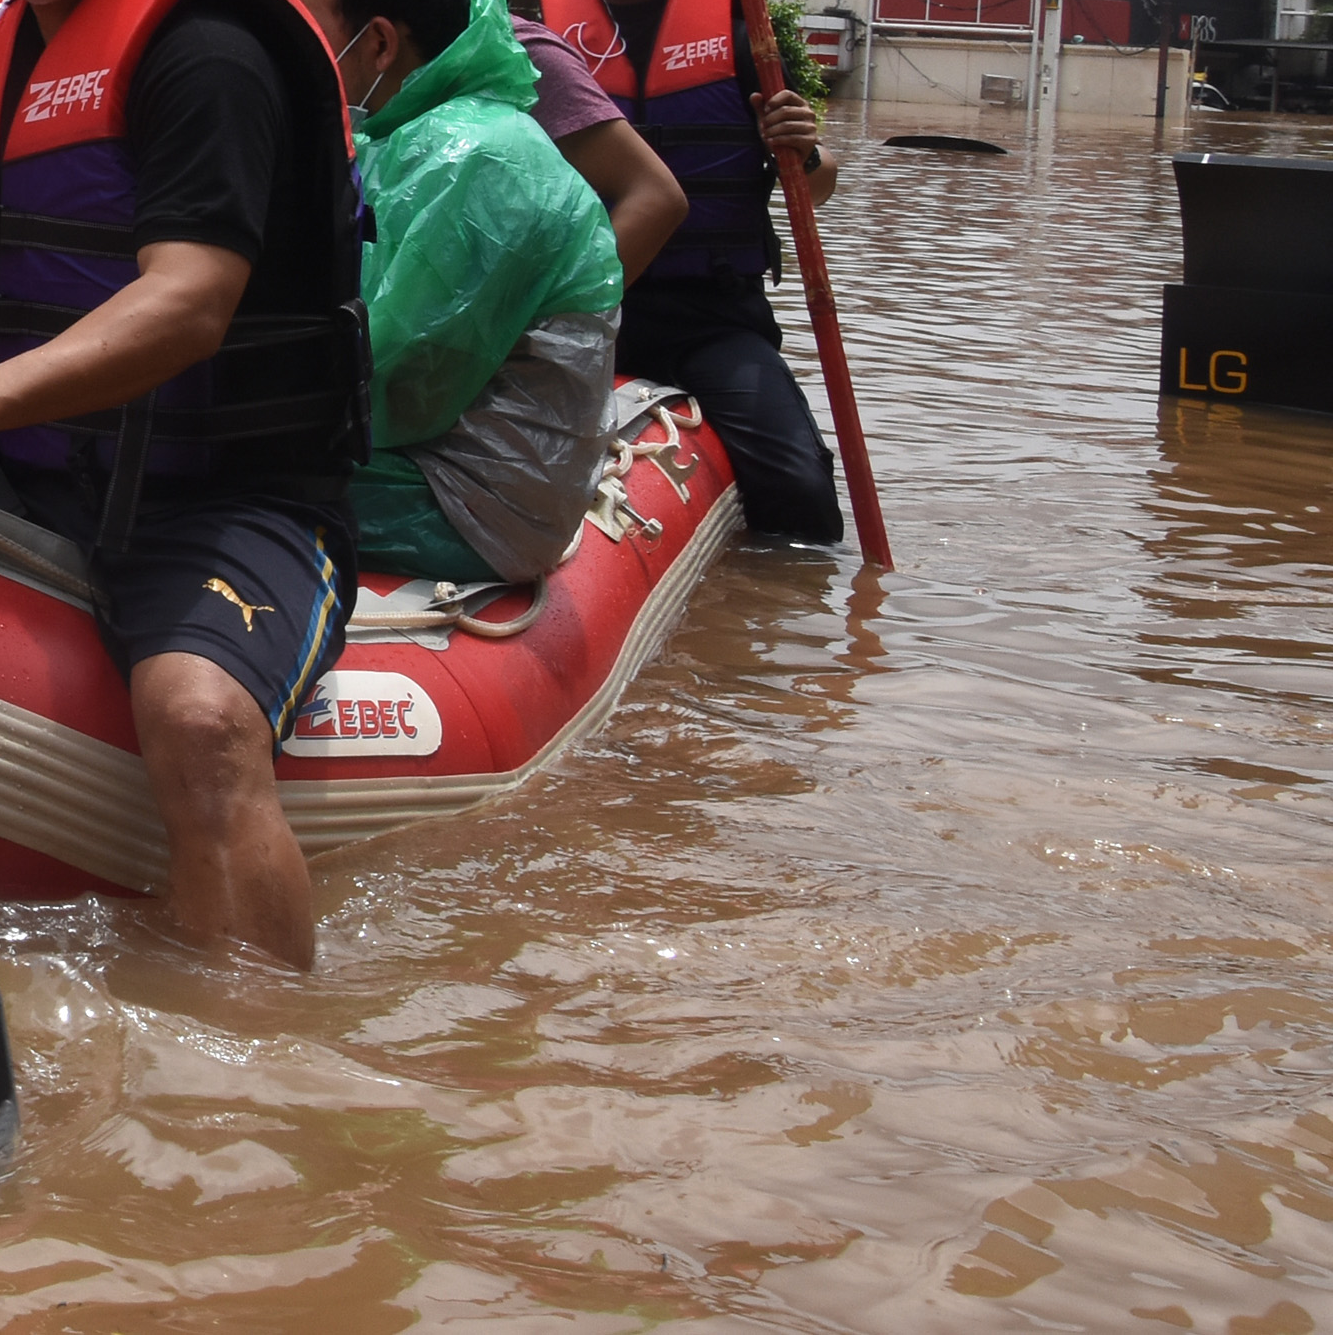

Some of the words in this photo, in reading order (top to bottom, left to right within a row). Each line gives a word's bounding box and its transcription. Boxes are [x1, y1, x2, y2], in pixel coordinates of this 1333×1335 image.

[661, 36, 728, 71] ZEBEC
[689, 51, 728, 66] LITE
[21, 68, 111, 123] ZEBEC
[52, 96, 102, 117] LITE
[1179, 347, 1248, 394] LG
